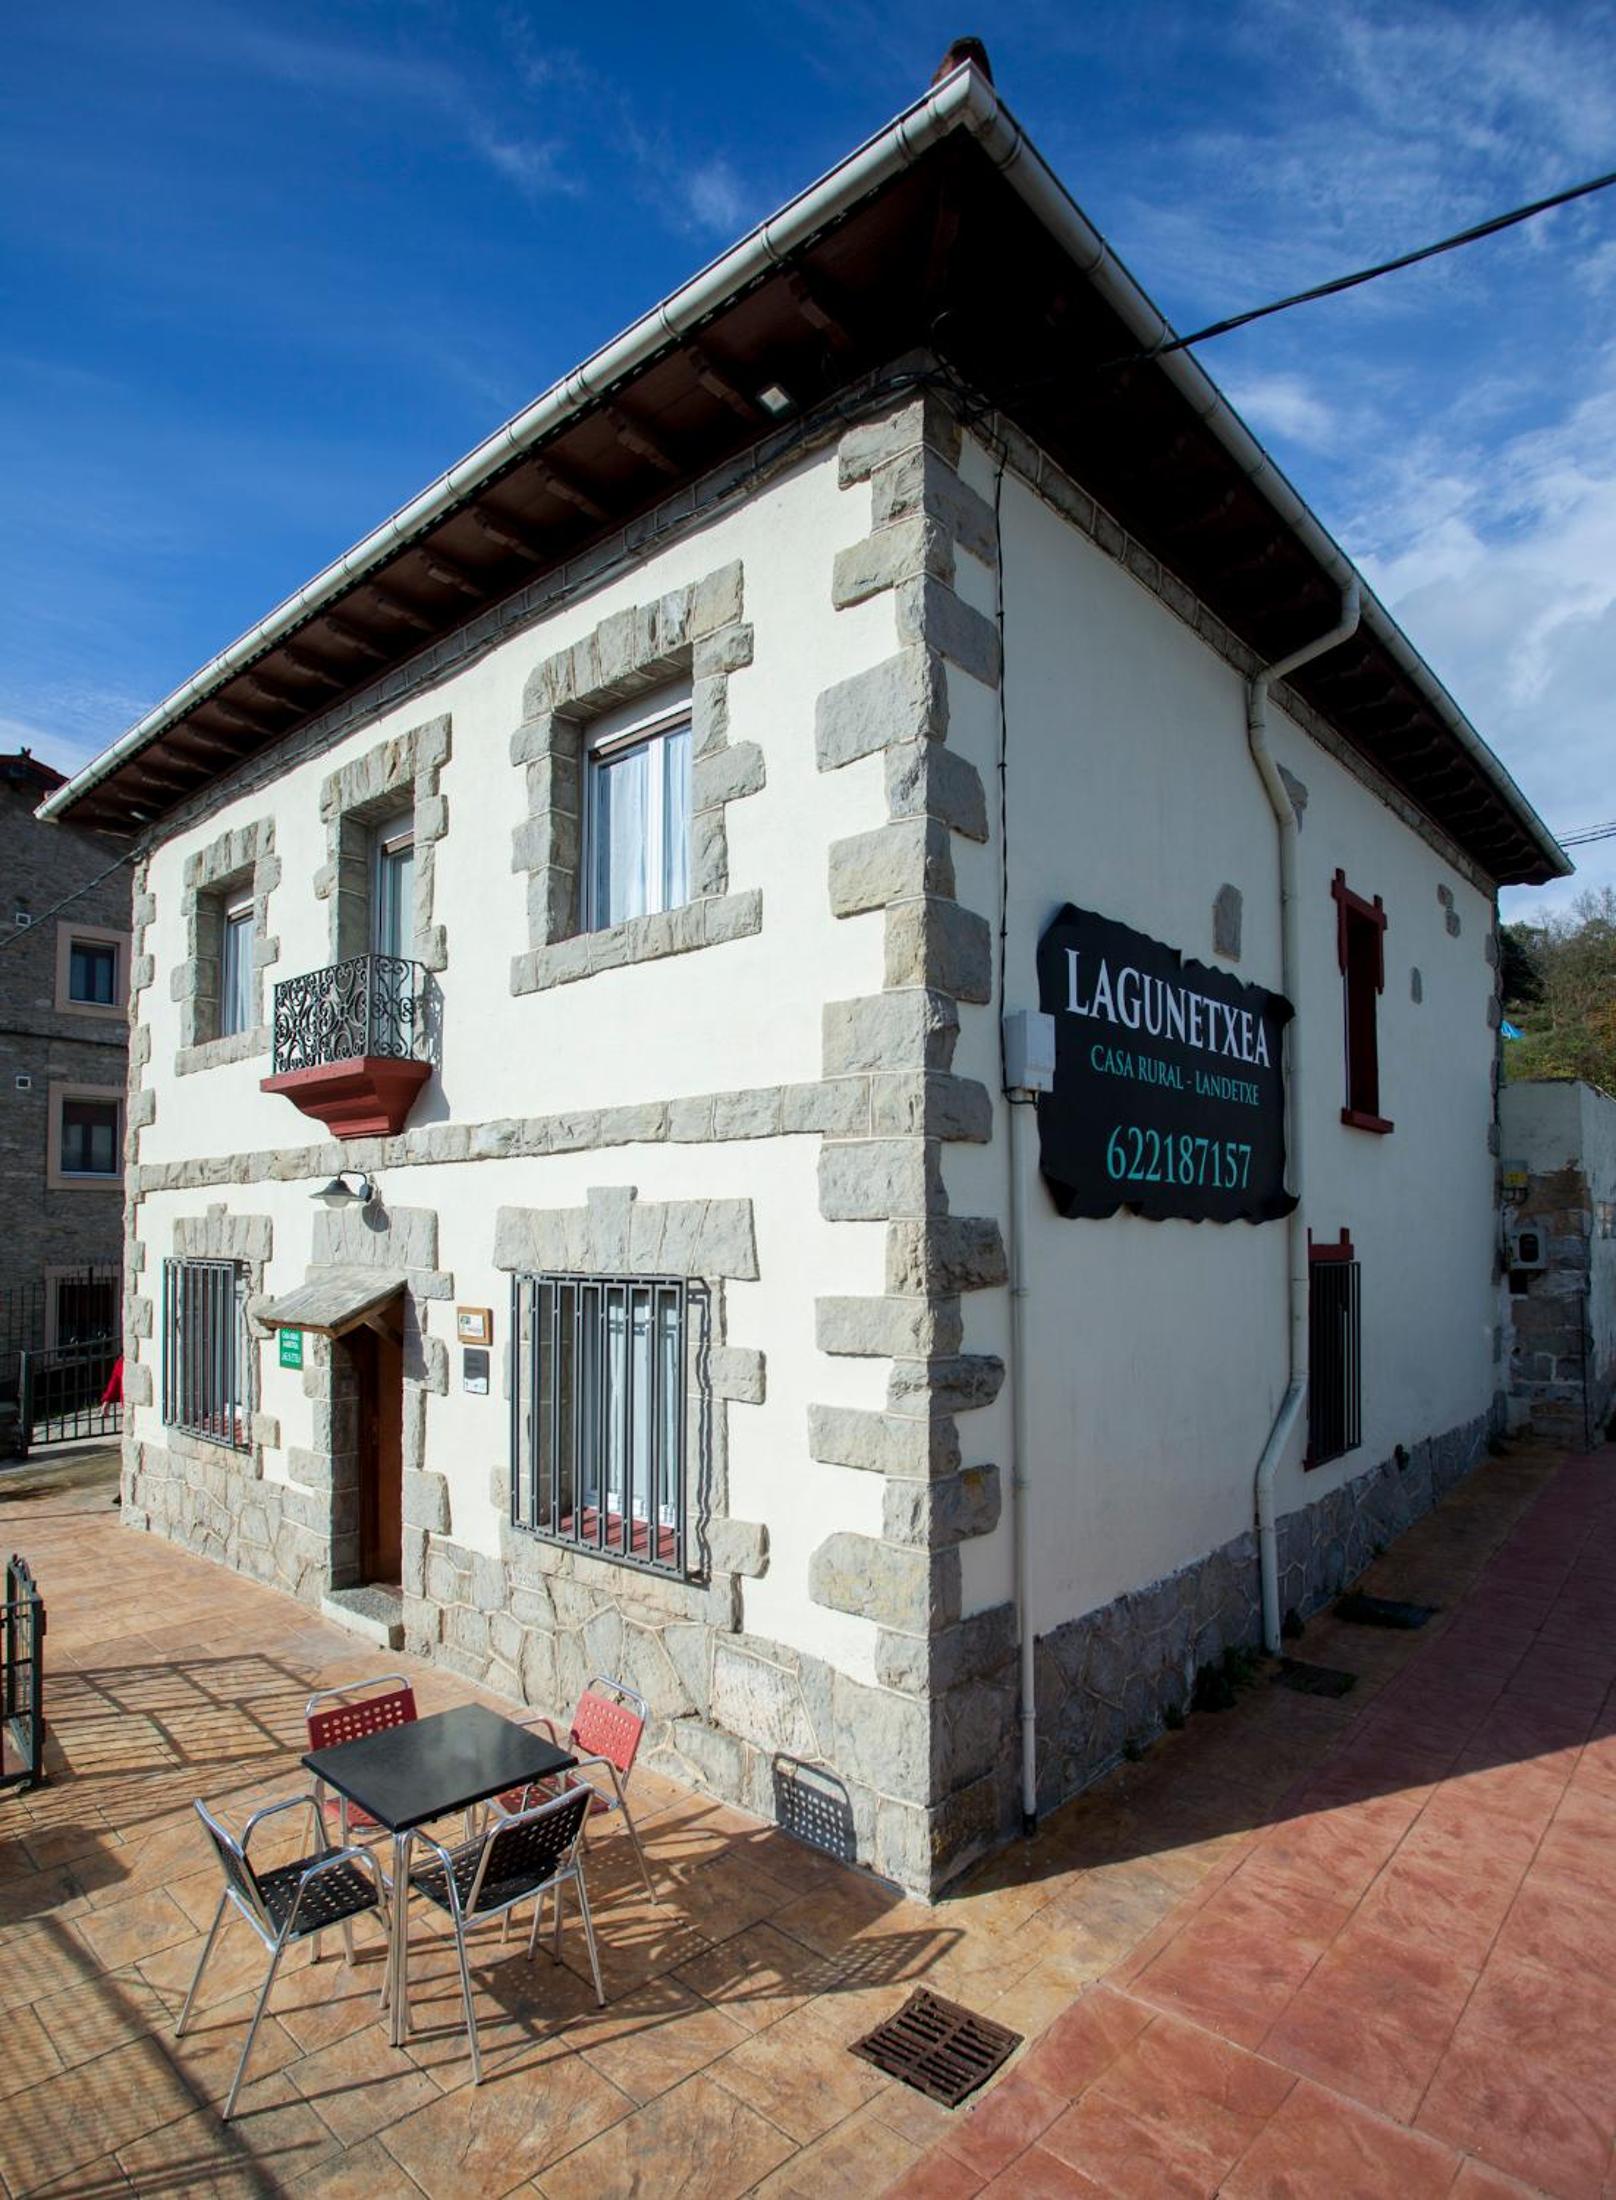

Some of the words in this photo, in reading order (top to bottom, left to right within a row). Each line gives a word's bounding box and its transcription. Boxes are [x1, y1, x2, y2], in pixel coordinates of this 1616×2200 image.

[1065, 948, 1271, 1068] LAGUNETXEA
[1090, 1044, 1135, 1078] CASA
[1138, 1055, 1184, 1090] RURAL
[1195, 1070, 1260, 1106] LANDETXE
[1106, 1125, 1252, 1189] 622187157
